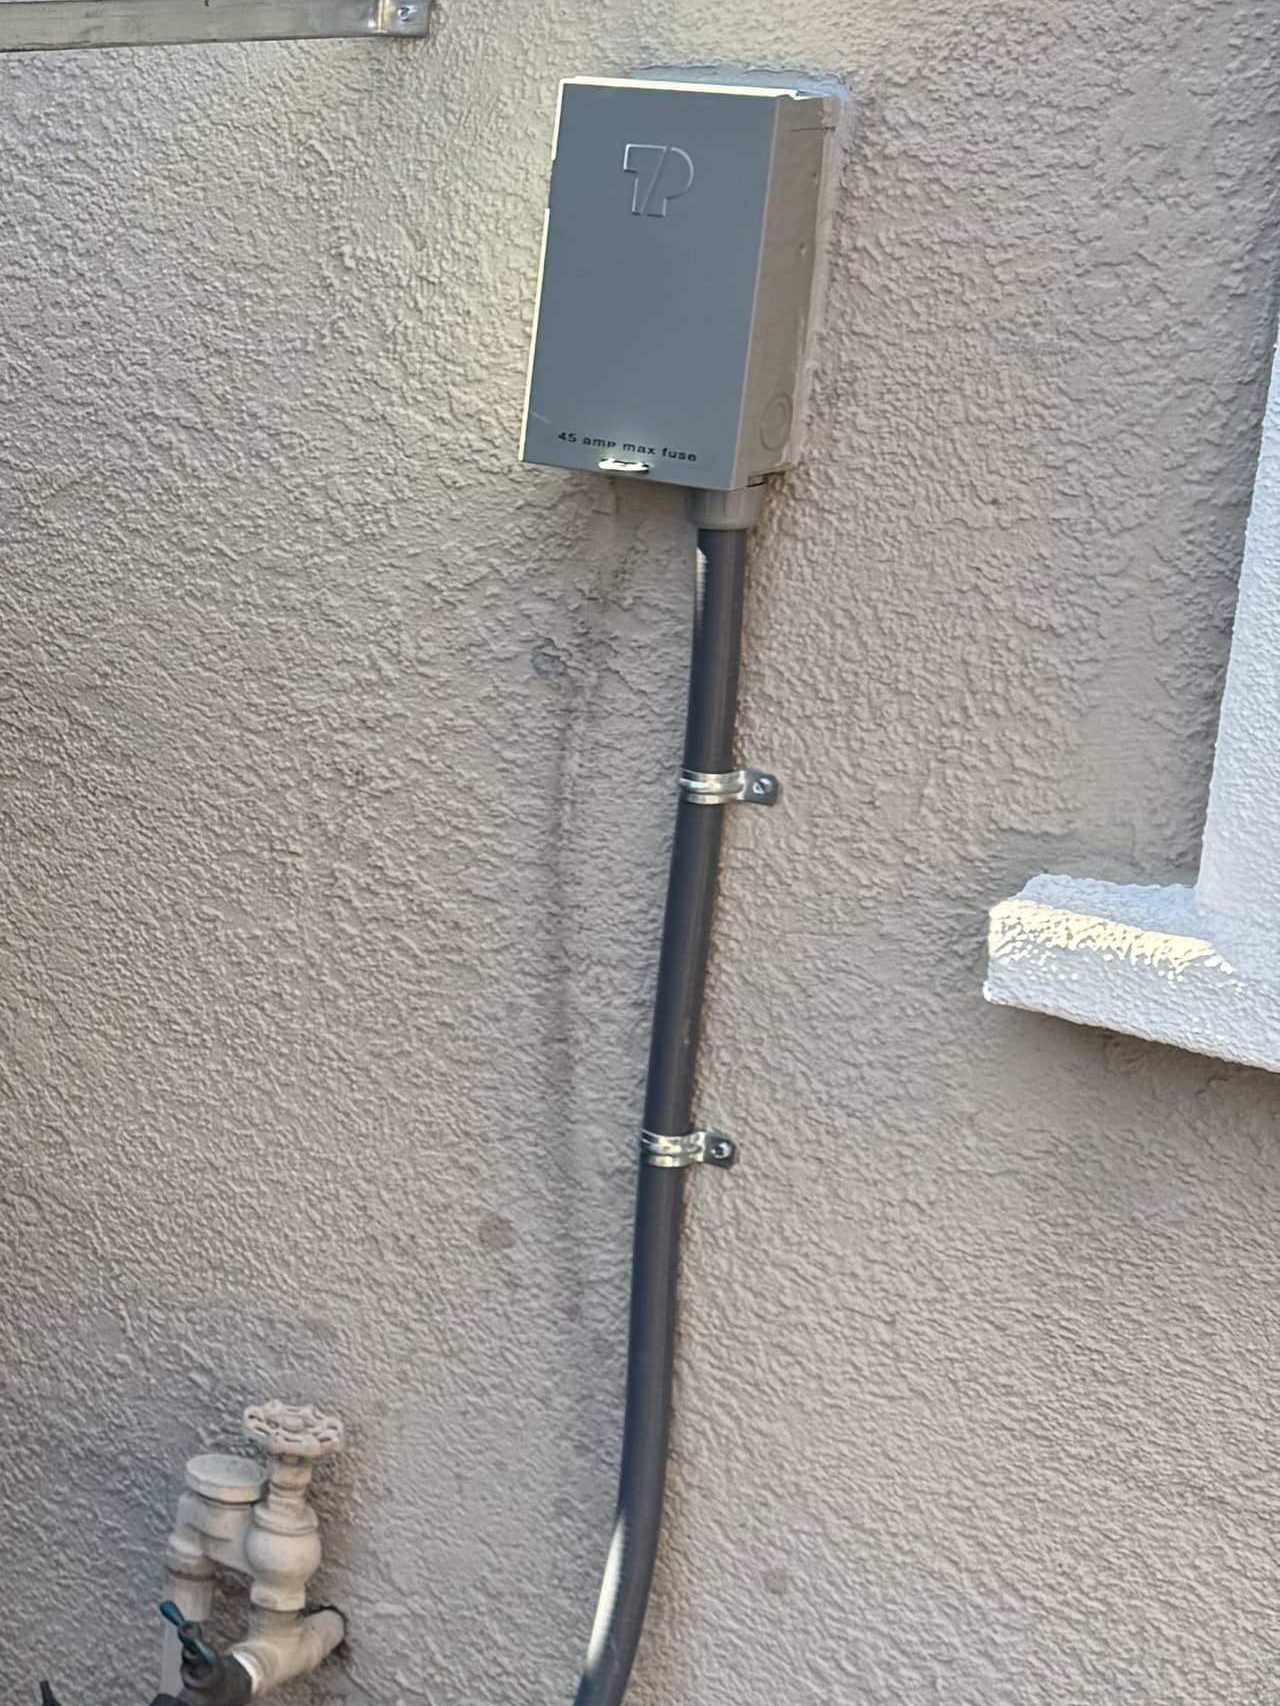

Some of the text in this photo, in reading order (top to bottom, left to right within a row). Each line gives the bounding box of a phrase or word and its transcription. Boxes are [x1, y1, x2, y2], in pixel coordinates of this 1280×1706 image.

[557, 431, 697, 462] 45 amp max fuse
